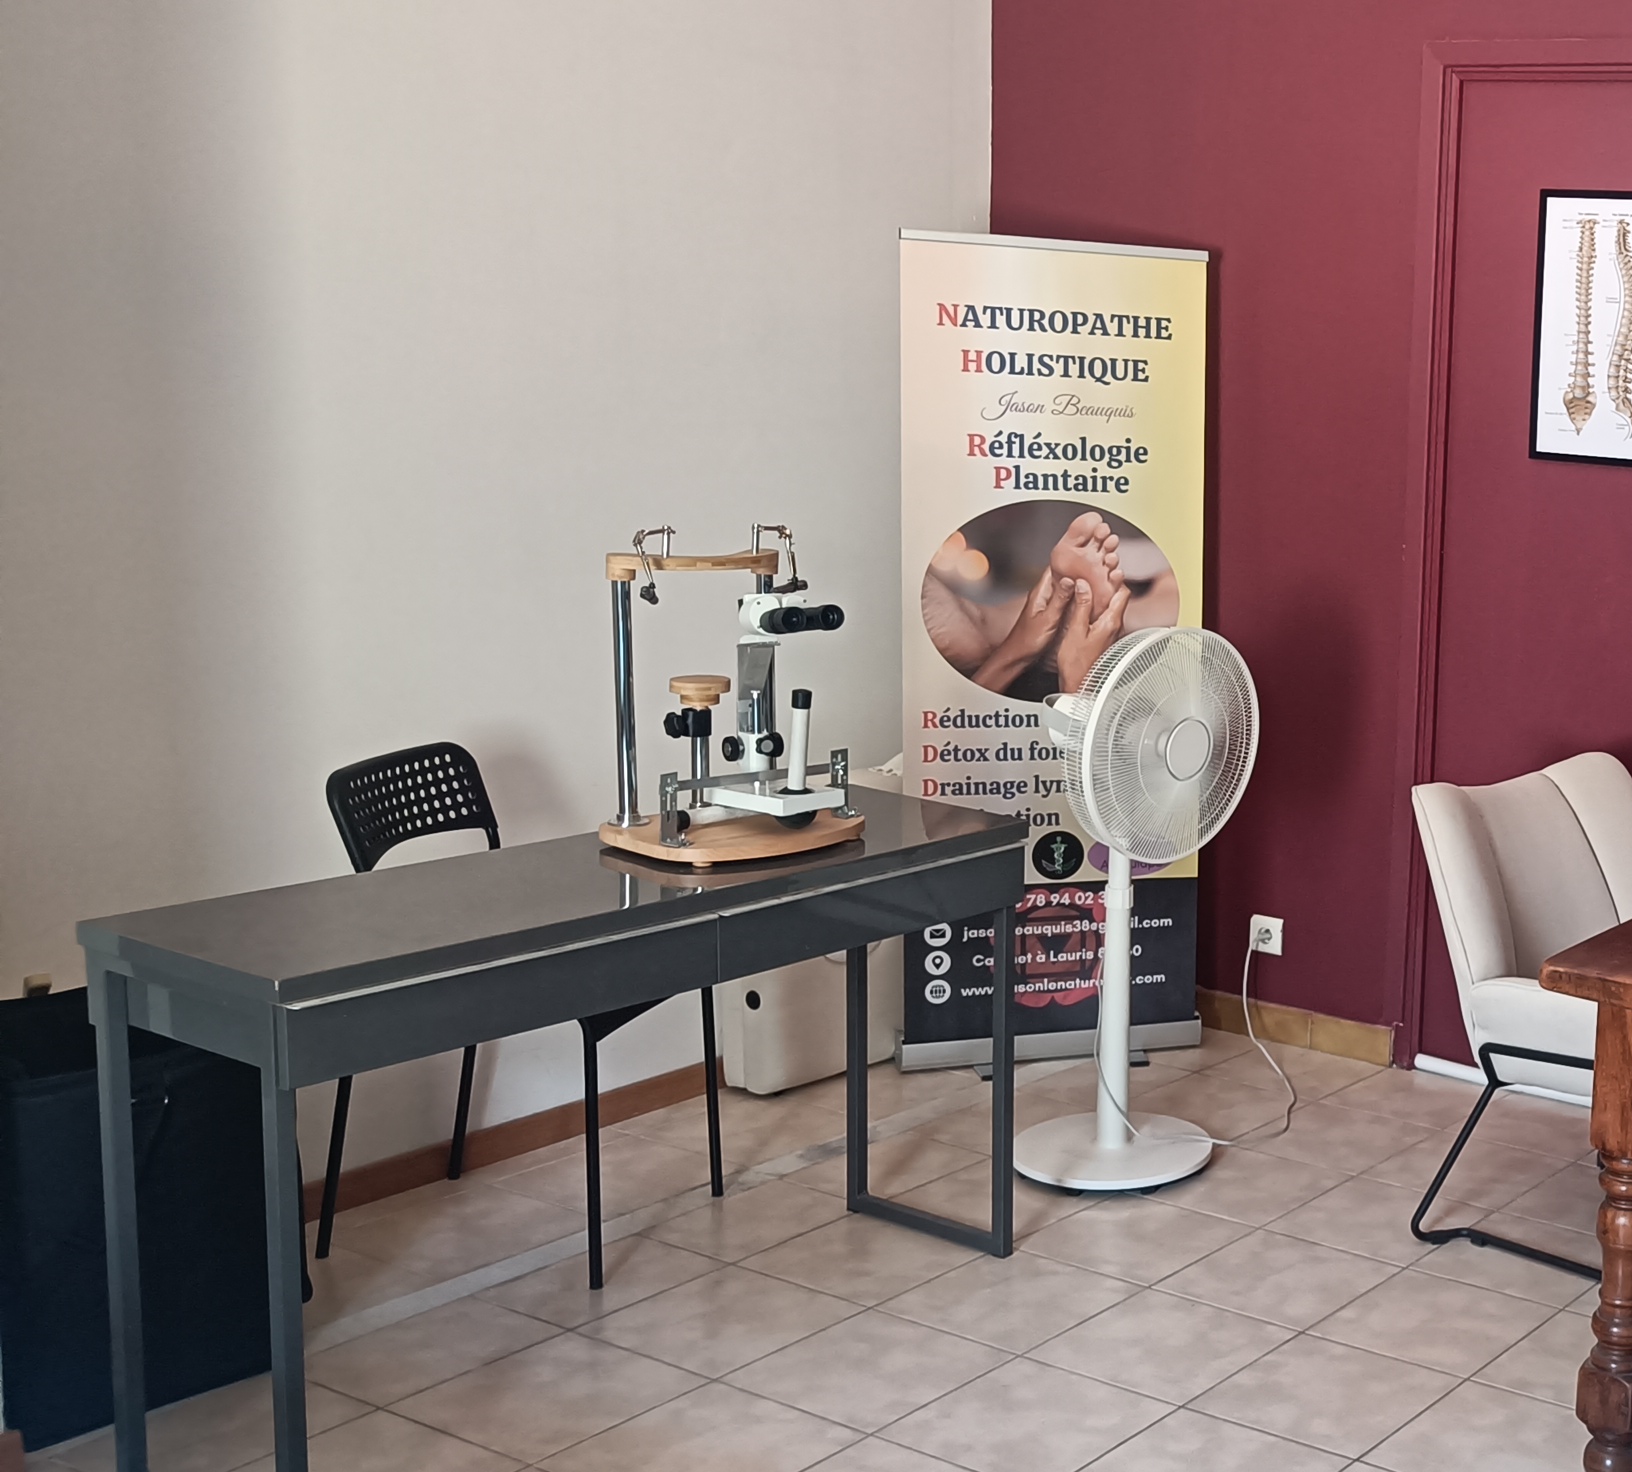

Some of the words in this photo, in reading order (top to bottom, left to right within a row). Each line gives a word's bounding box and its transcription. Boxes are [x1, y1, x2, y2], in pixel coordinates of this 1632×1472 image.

[936, 303, 1173, 341] NATUROPATHE
[961, 349, 1150, 386] HOLISTIQUE
[980, 390, 1047, 421] Jason
[1051, 393, 1136, 424] Beauquis
[967, 430, 1149, 469] Réfléxologie
[993, 465, 1130, 494] Plantaire
[922, 707, 1040, 729] Réduction
[922, 741, 990, 763] Détox
[995, 742, 1023, 761] du
[922, 775, 1028, 800] Drainage
[1026, 894, 1046, 907] 78
[1050, 892, 1071, 906] 94
[1075, 892, 1094, 905] 02
[1036, 949, 1046, 963] à
[1050, 949, 1094, 962] Lauris
